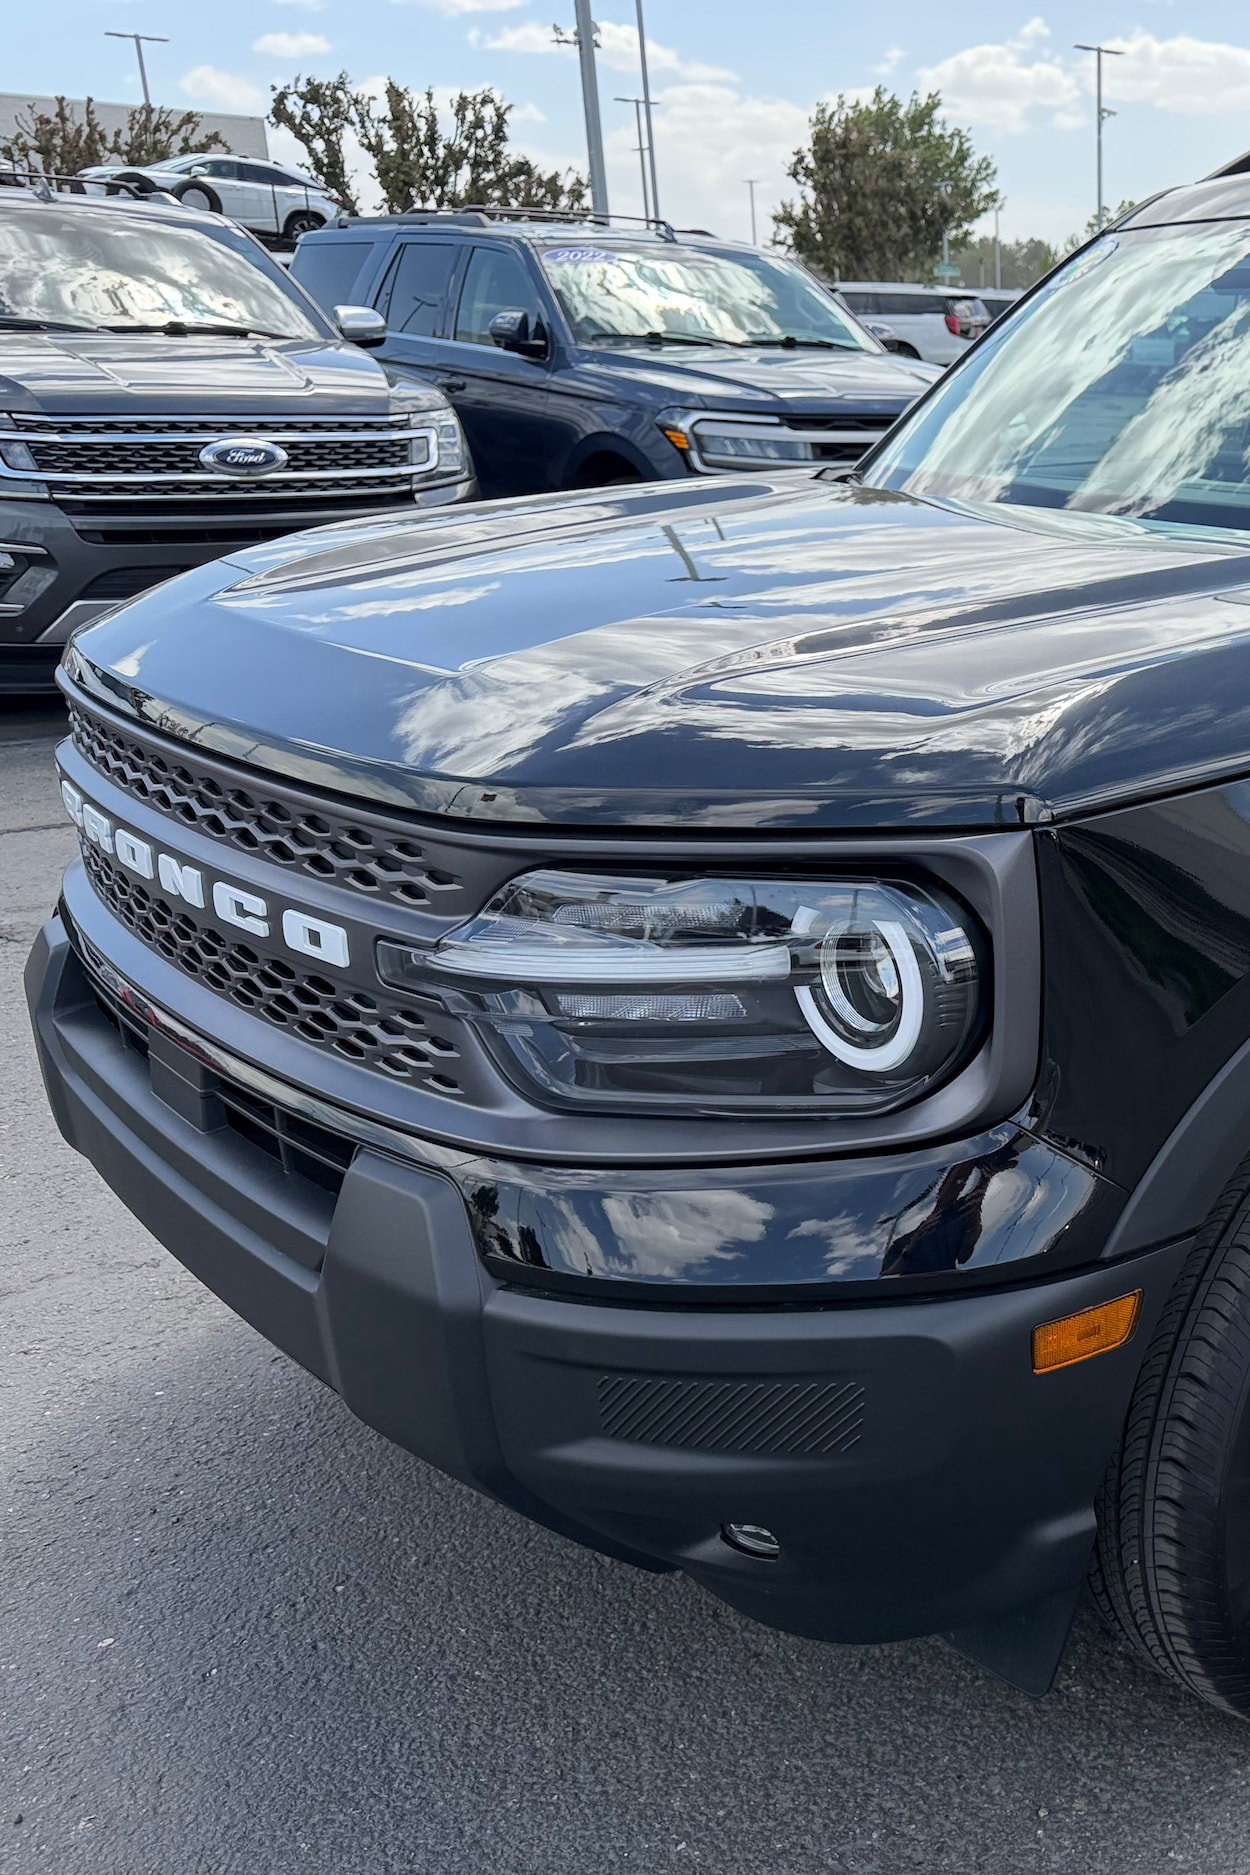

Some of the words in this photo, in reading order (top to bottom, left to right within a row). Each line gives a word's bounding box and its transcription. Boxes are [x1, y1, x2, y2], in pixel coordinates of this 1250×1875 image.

[555, 249, 607, 262] 2022
[226, 447, 266, 464] Ford
[61, 779, 351, 969] BRONCO
